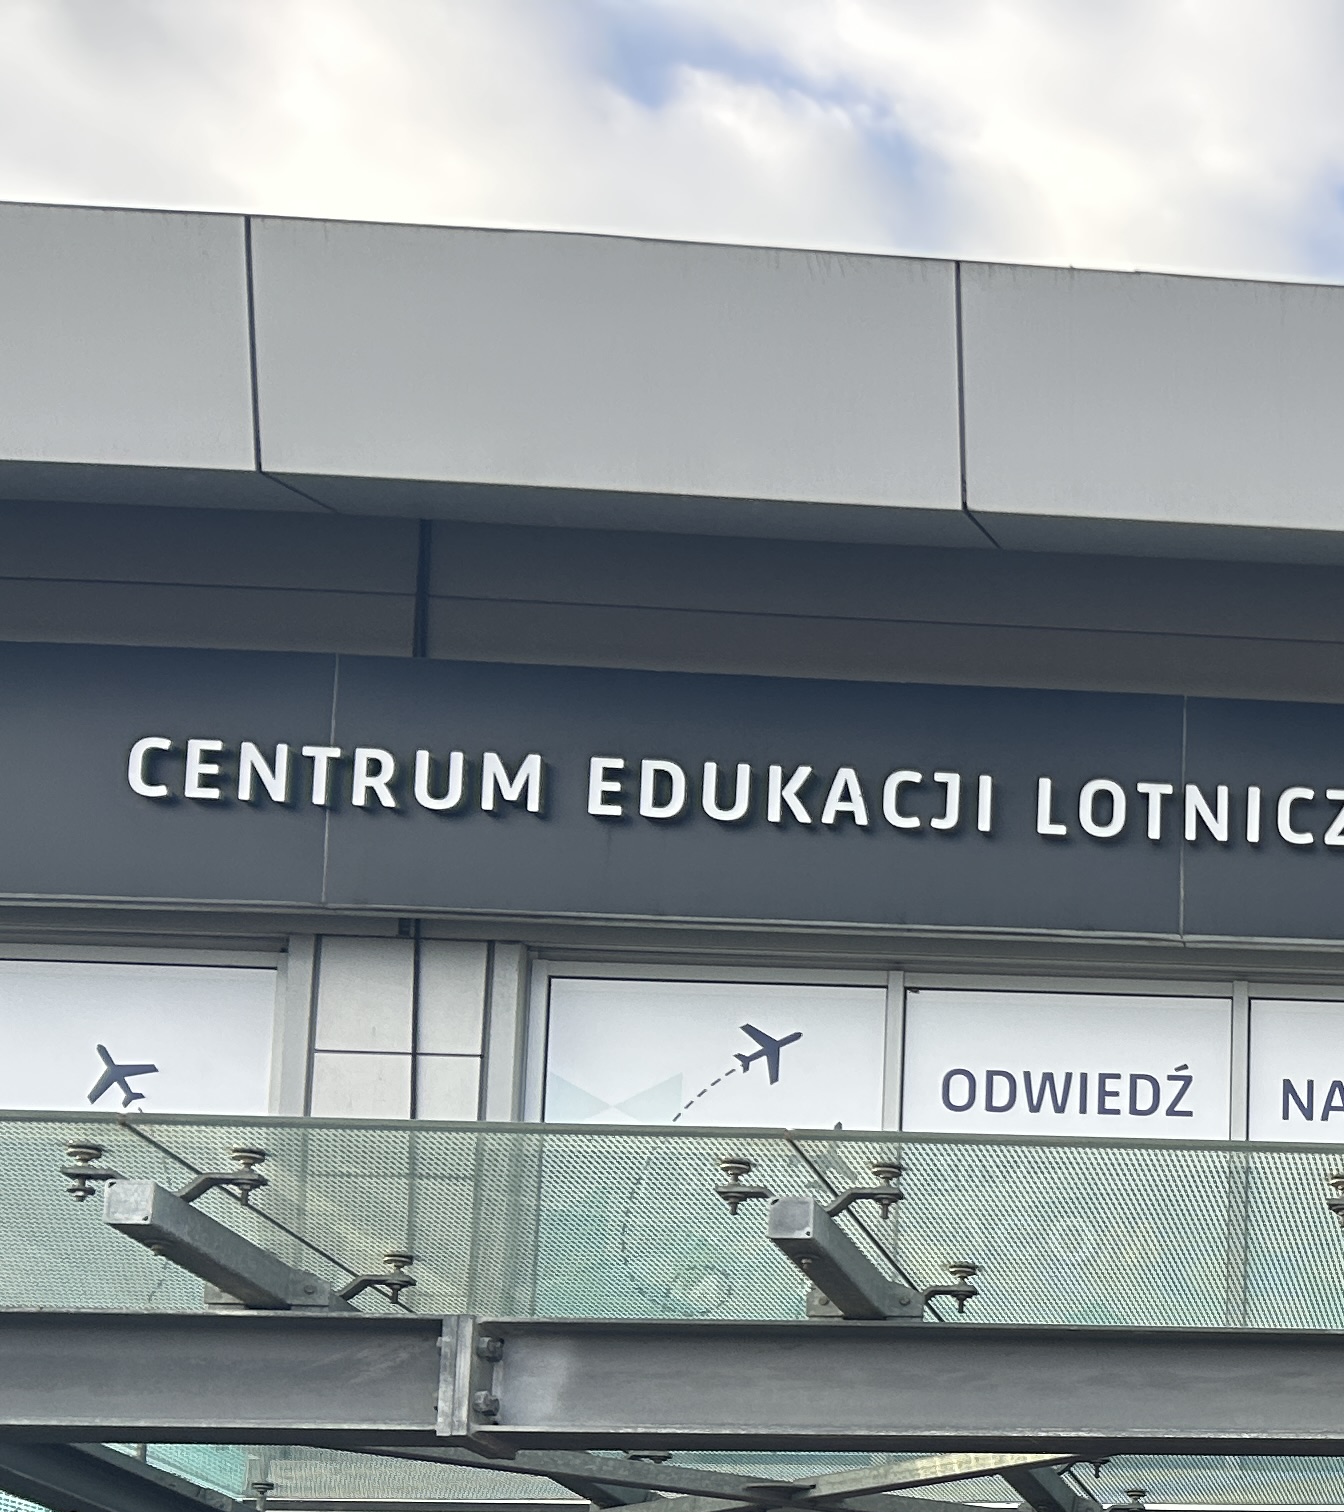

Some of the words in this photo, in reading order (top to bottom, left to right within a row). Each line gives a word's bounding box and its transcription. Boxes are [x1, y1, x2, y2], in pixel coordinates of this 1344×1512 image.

[127, 736, 542, 815] CENTRUM
[587, 755, 993, 833] EDUKACJI
[941, 1063, 1194, 1117] ODWIEDŹ
